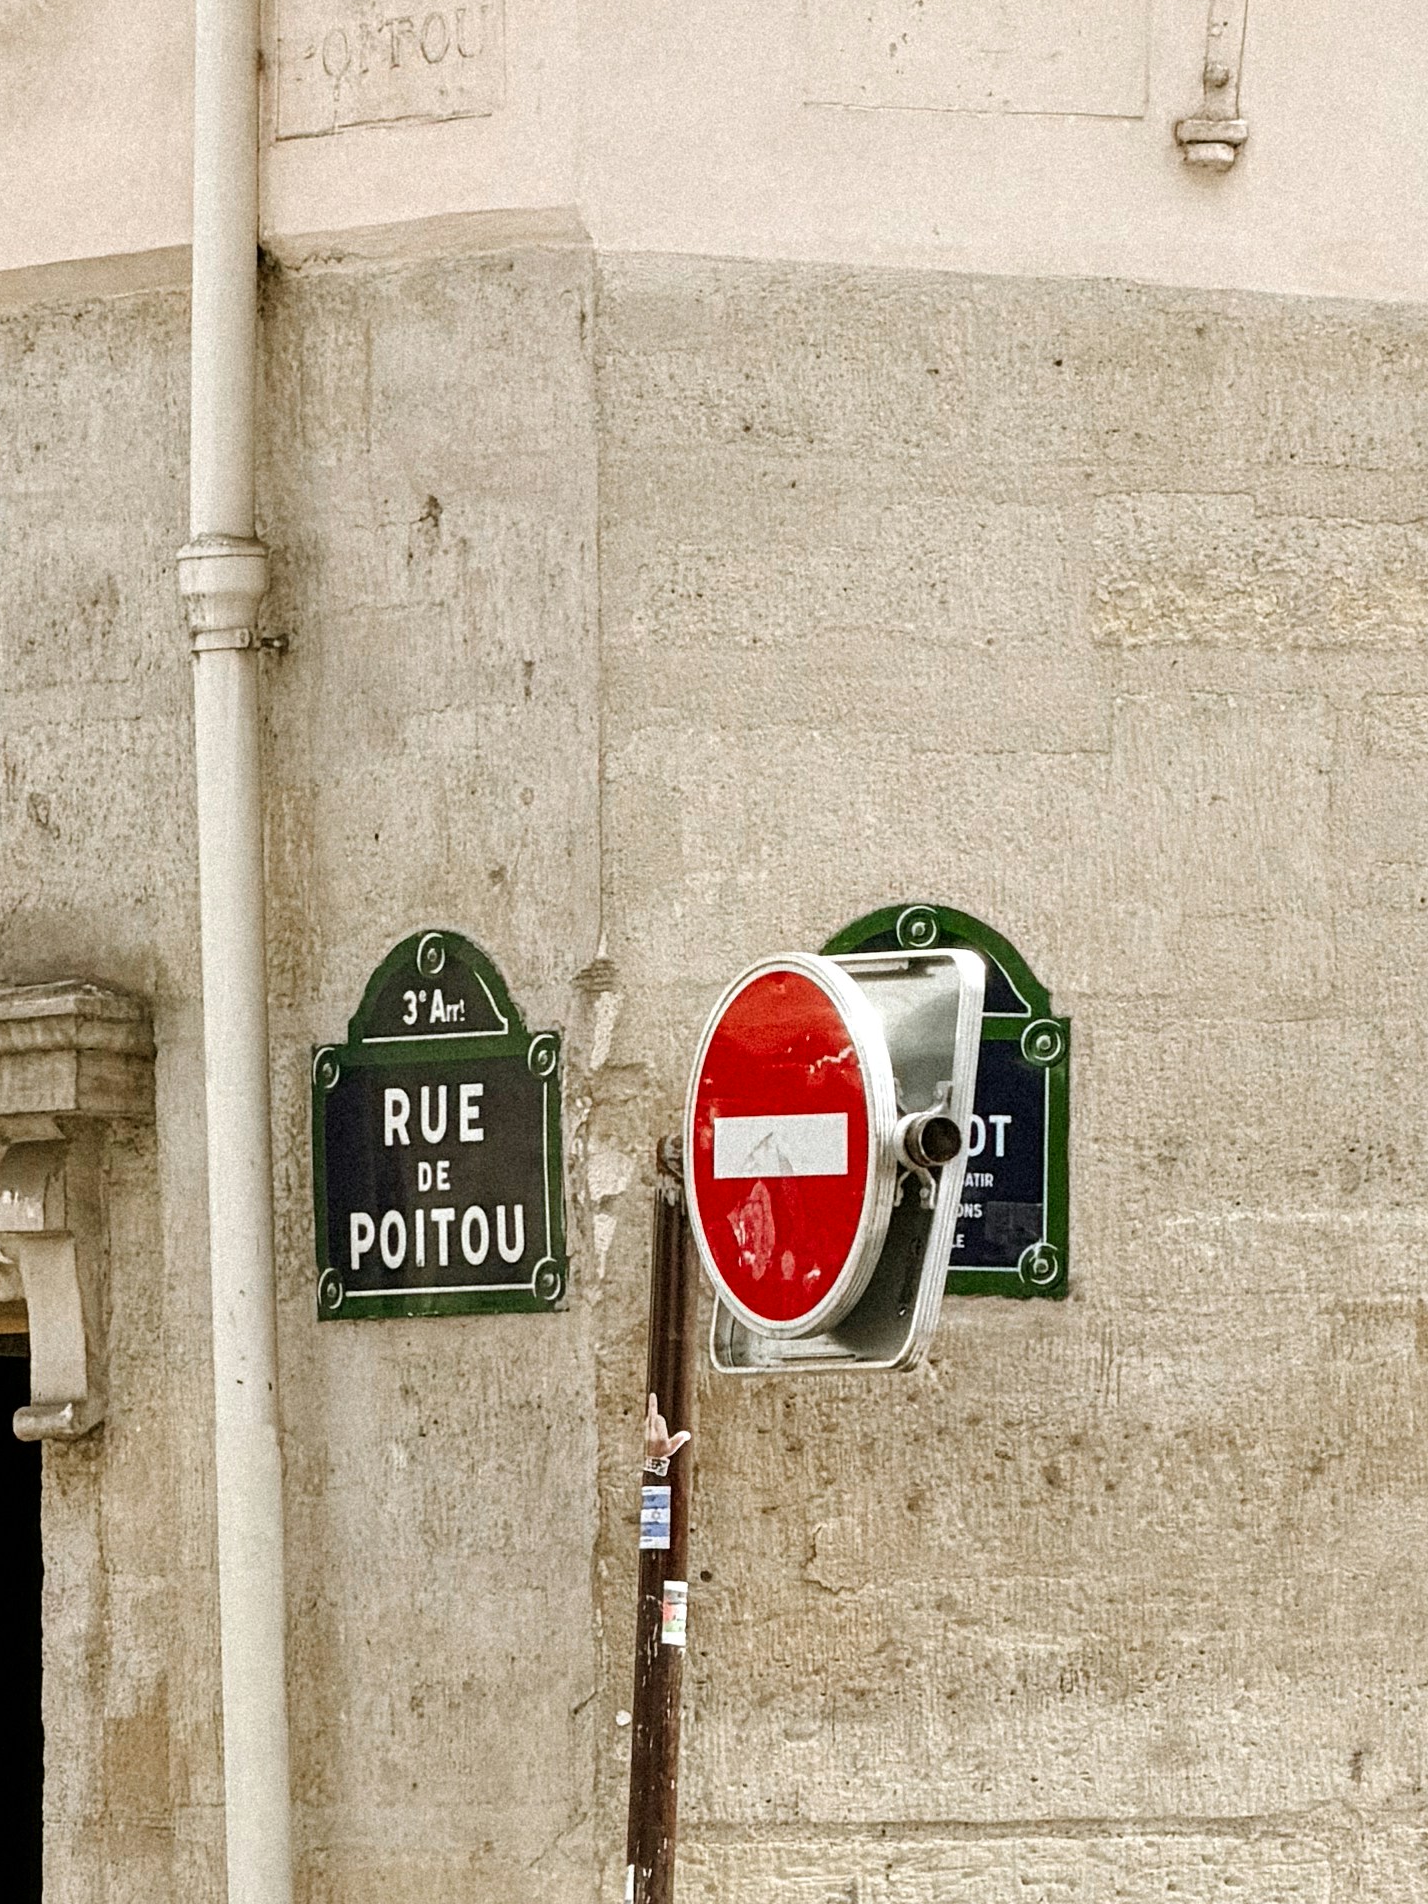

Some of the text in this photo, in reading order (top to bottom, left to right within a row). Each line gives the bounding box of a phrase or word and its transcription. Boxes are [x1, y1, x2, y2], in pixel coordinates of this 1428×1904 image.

[384, 1082, 485, 1146] RUE
[417, 1160, 451, 1192] DE
[350, 1203, 525, 1270] POITOU
